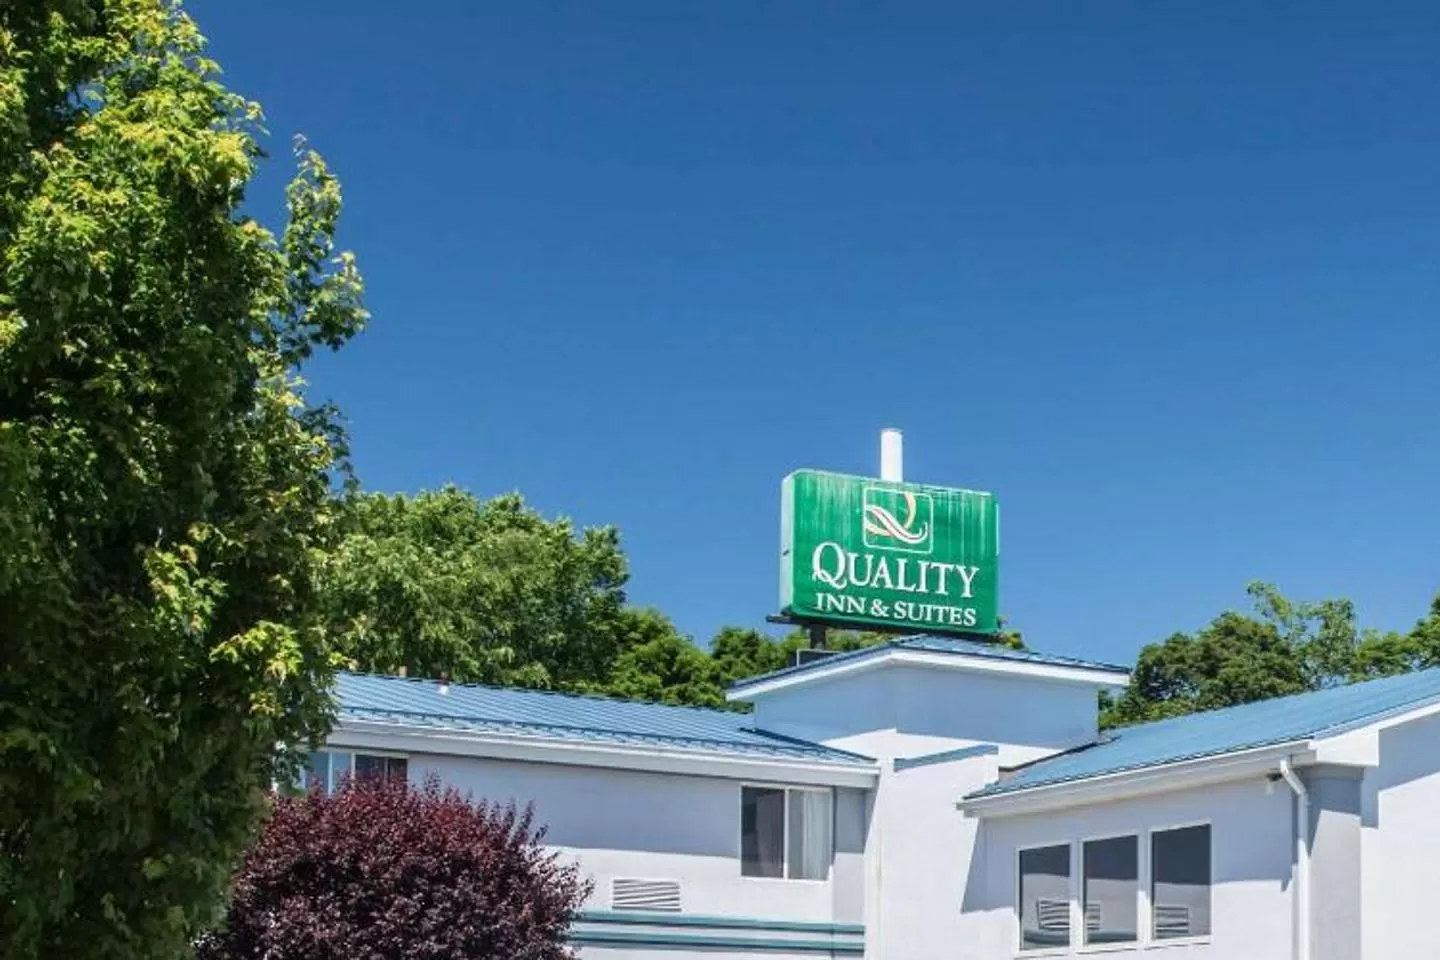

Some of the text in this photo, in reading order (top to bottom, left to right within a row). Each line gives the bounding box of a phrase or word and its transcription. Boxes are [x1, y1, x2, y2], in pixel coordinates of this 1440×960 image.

[812, 541, 980, 598] QUALITY
[815, 592, 977, 626] INN & SUITES
